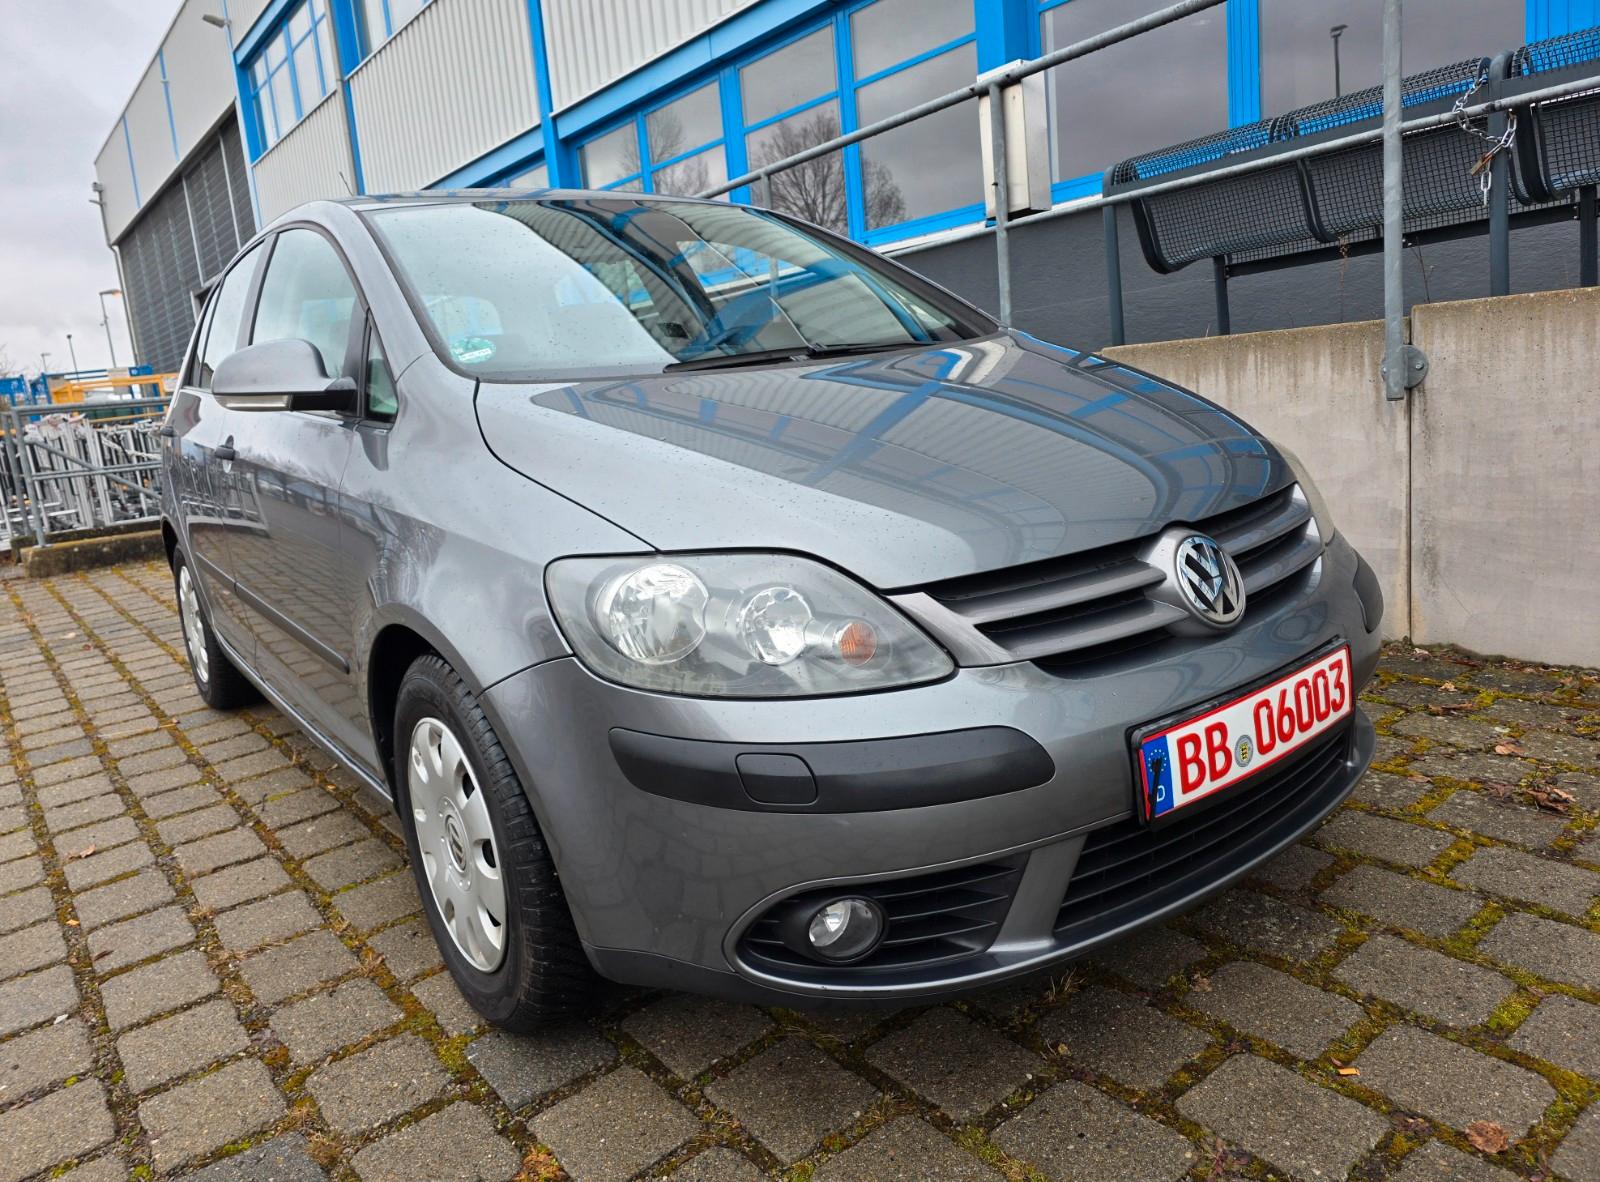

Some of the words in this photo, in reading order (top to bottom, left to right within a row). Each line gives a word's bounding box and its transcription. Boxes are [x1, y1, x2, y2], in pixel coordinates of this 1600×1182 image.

[1177, 536, 1243, 622] VW
[1177, 721, 1233, 795] BB
[1253, 659, 1346, 756] 06003
[1156, 785, 1166, 802] D
